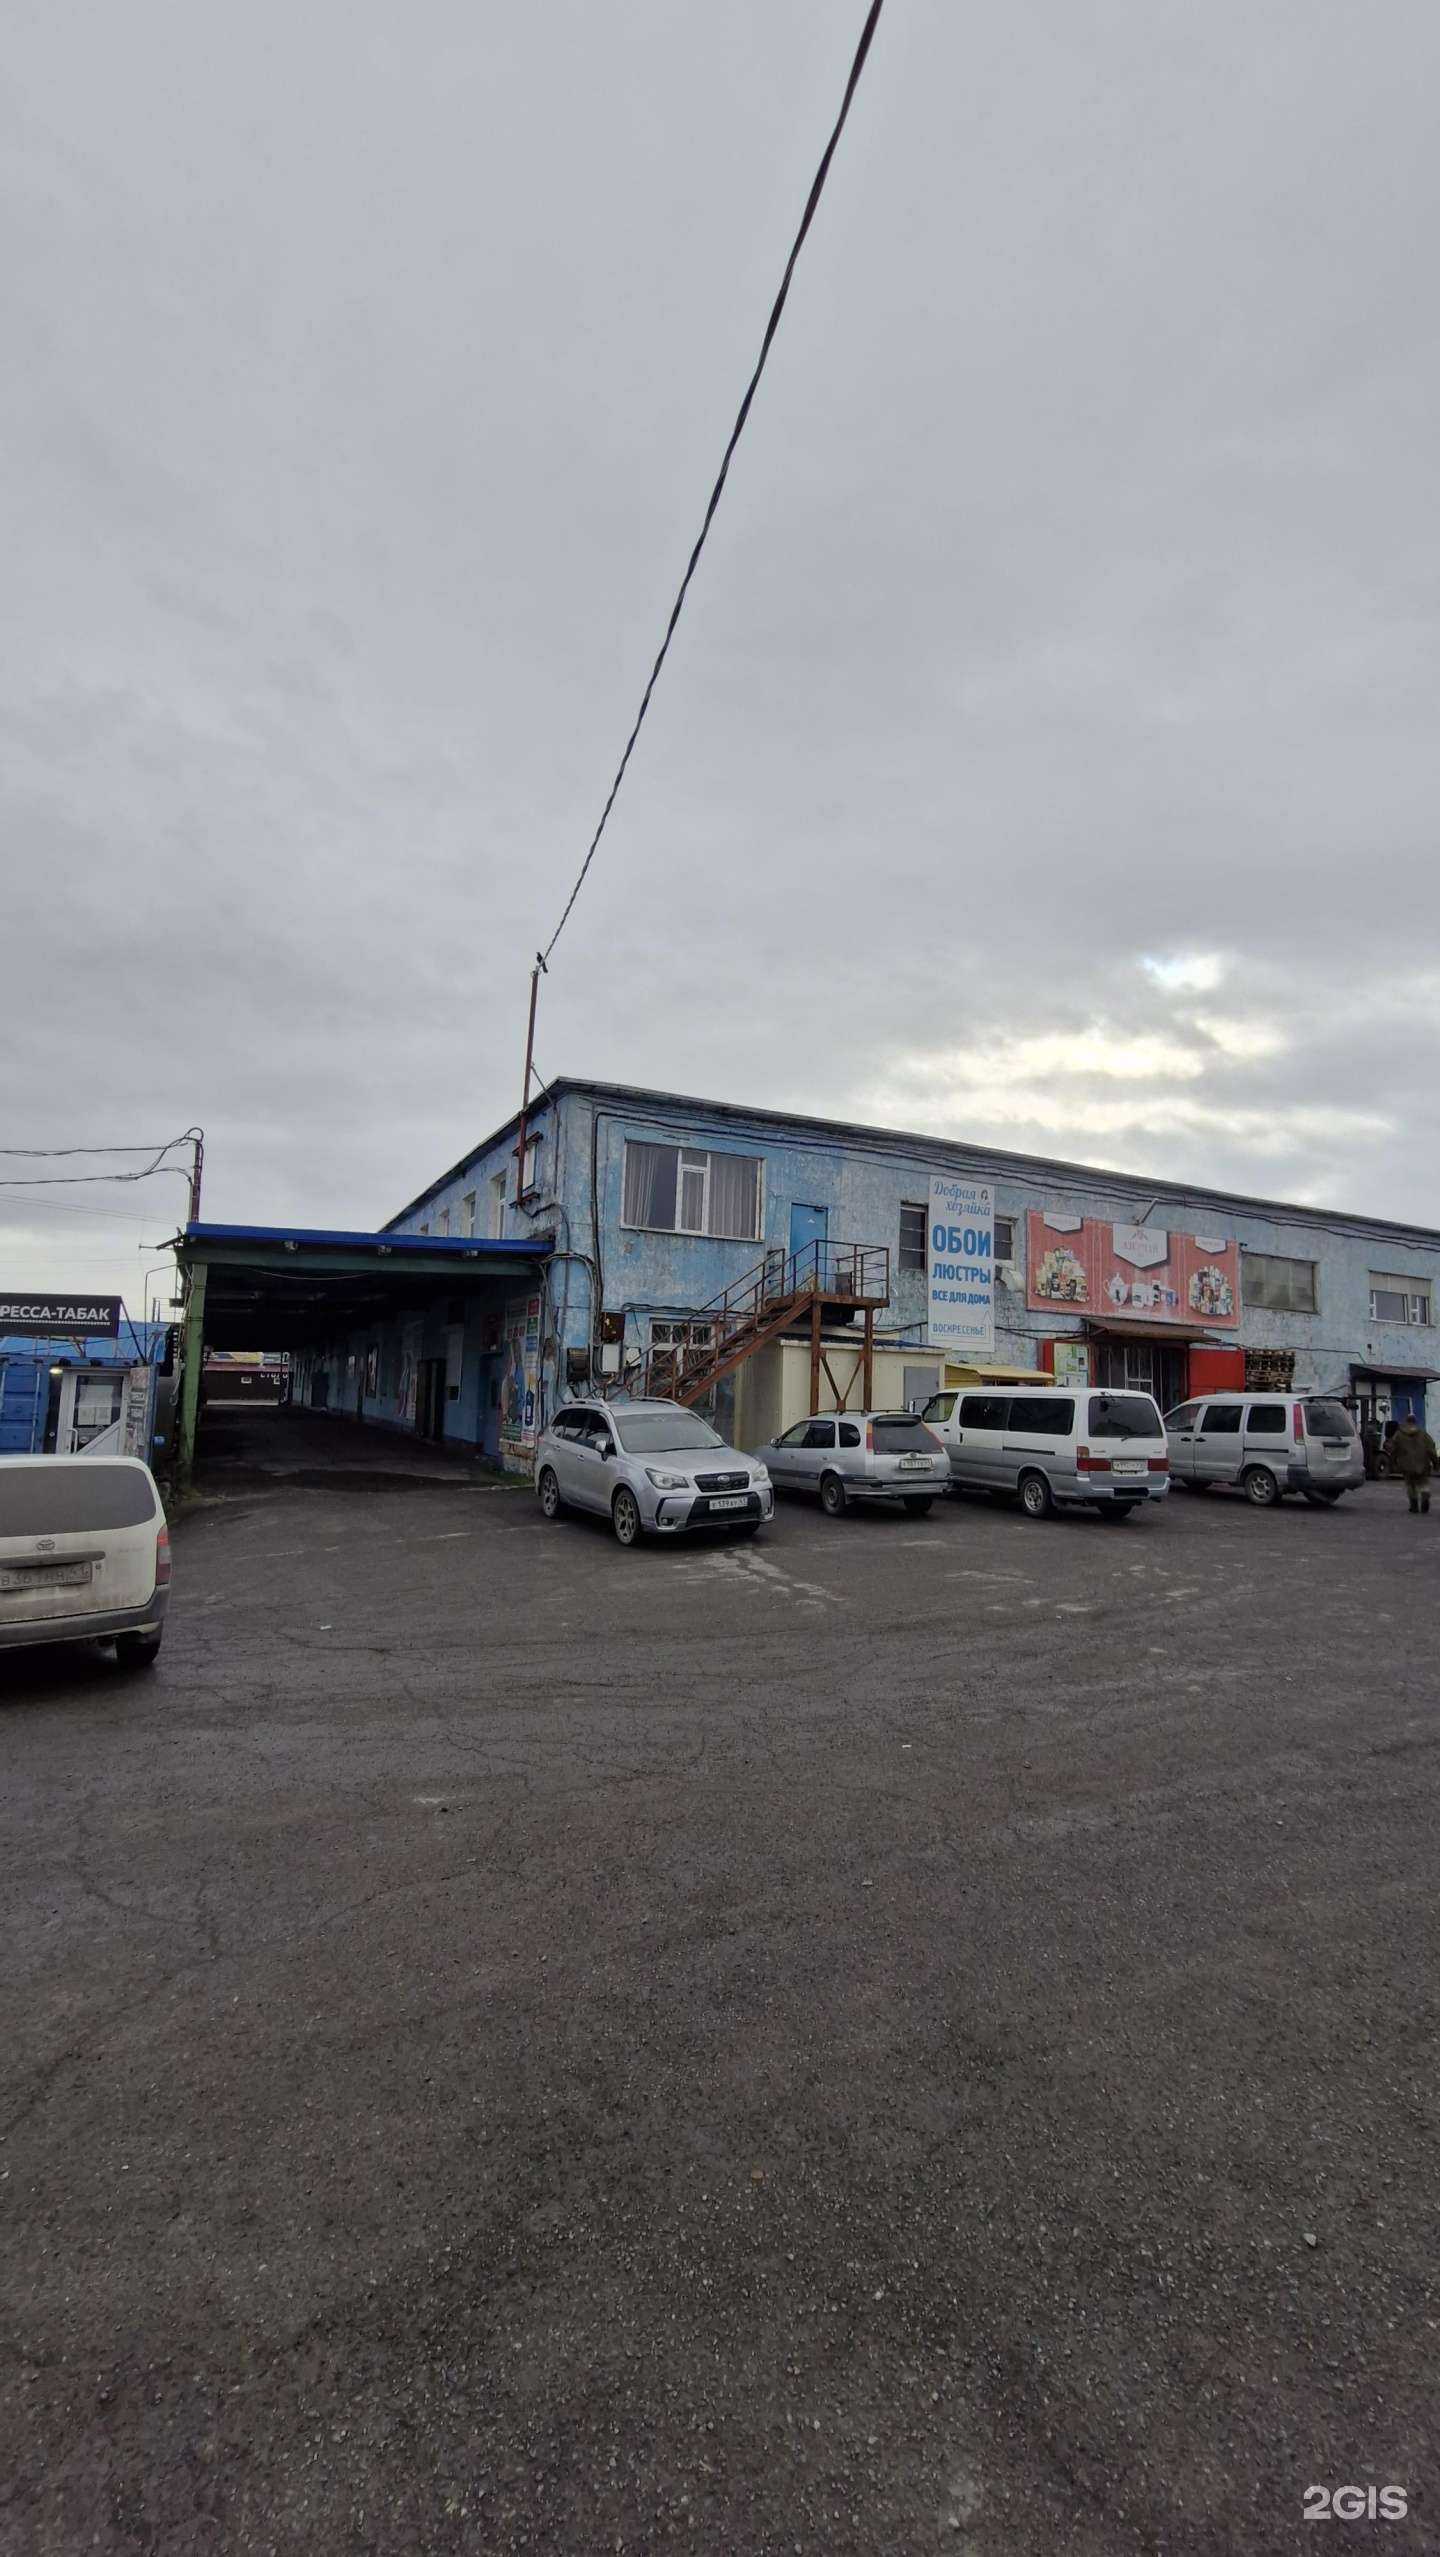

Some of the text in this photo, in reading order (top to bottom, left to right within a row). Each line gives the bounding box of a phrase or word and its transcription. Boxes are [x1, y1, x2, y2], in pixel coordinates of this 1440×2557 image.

[934, 1181, 976, 1200] Добрая
[945, 1200, 991, 1216] хозяйка
[932, 1224, 991, 1257] ОБОИ
[932, 1263, 991, 1284] ЛЮСТРЫ
[932, 1289, 991, 1305] ВСЕ ДЛЯ ДОМА
[932, 1323, 985, 1336] ВОСКРЕСЕНЬЕ
